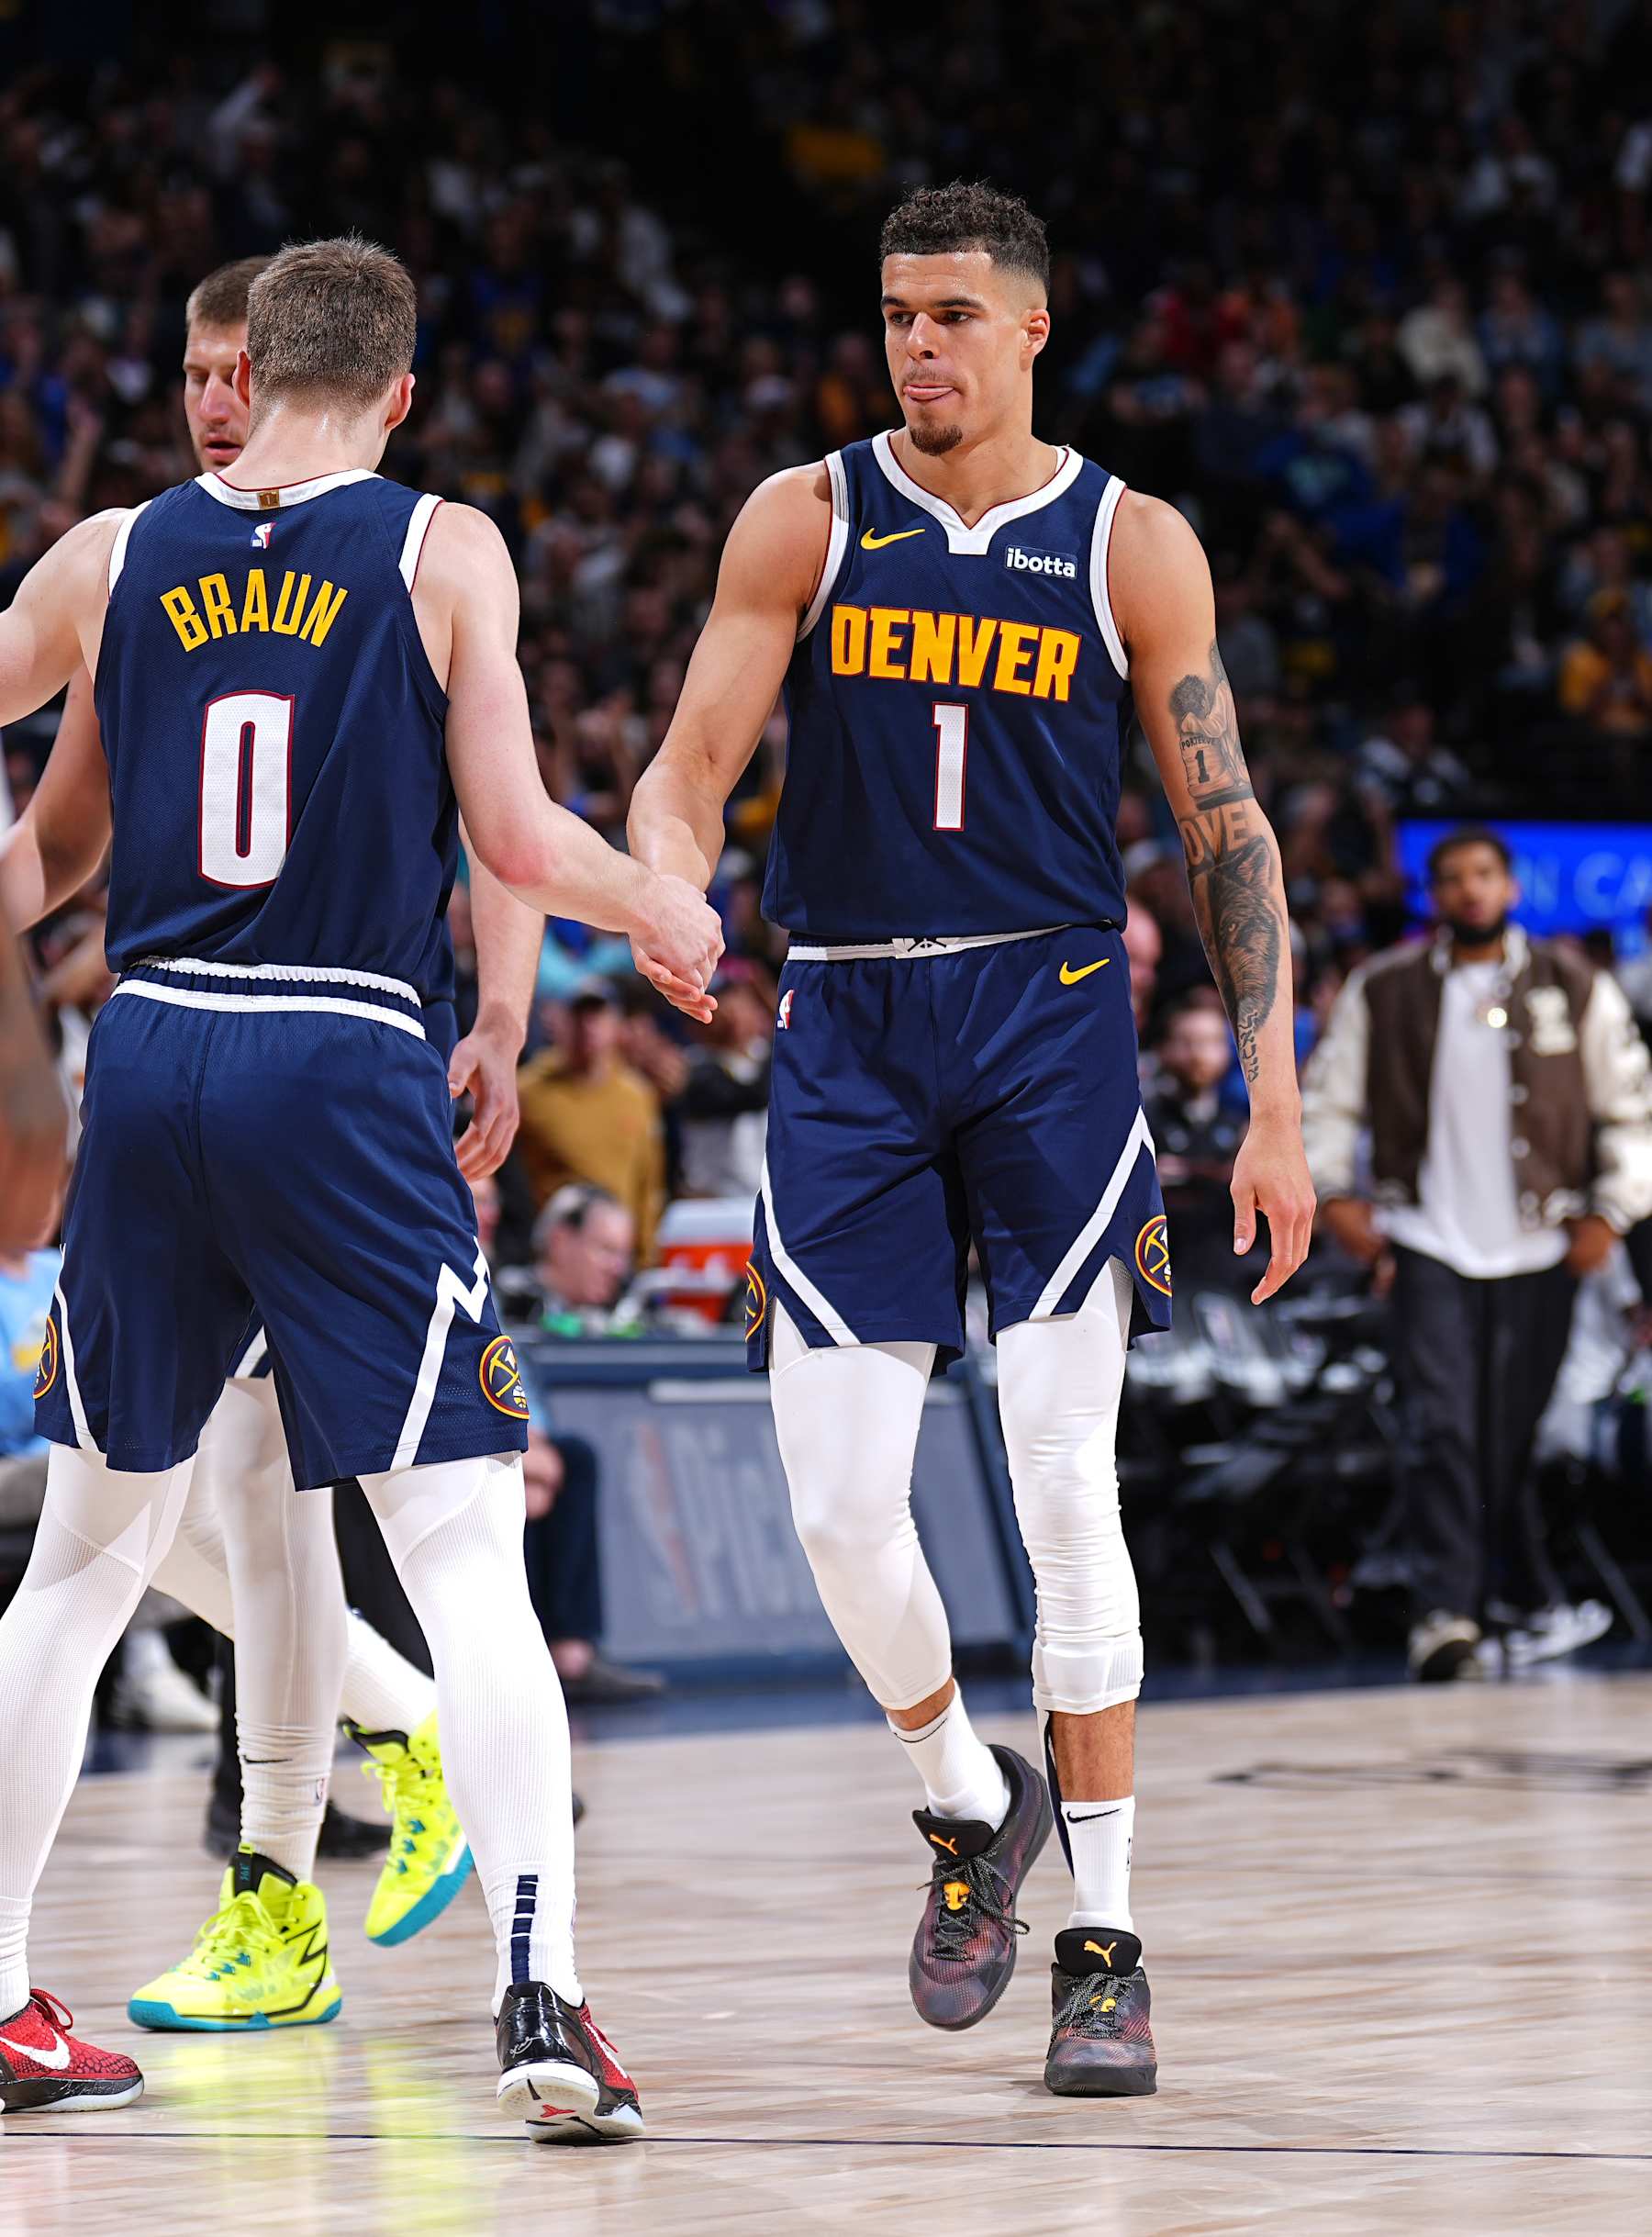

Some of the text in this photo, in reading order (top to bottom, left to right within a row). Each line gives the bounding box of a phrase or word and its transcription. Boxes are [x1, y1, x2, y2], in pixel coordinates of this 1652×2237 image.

[1006, 547, 1076, 578] ibotta
[160, 568, 348, 653] BRAUN
[831, 602, 1082, 703] DENVER
[198, 689, 296, 890] 0
[932, 701, 968, 831] 1
[1195, 750, 1210, 783] 1
